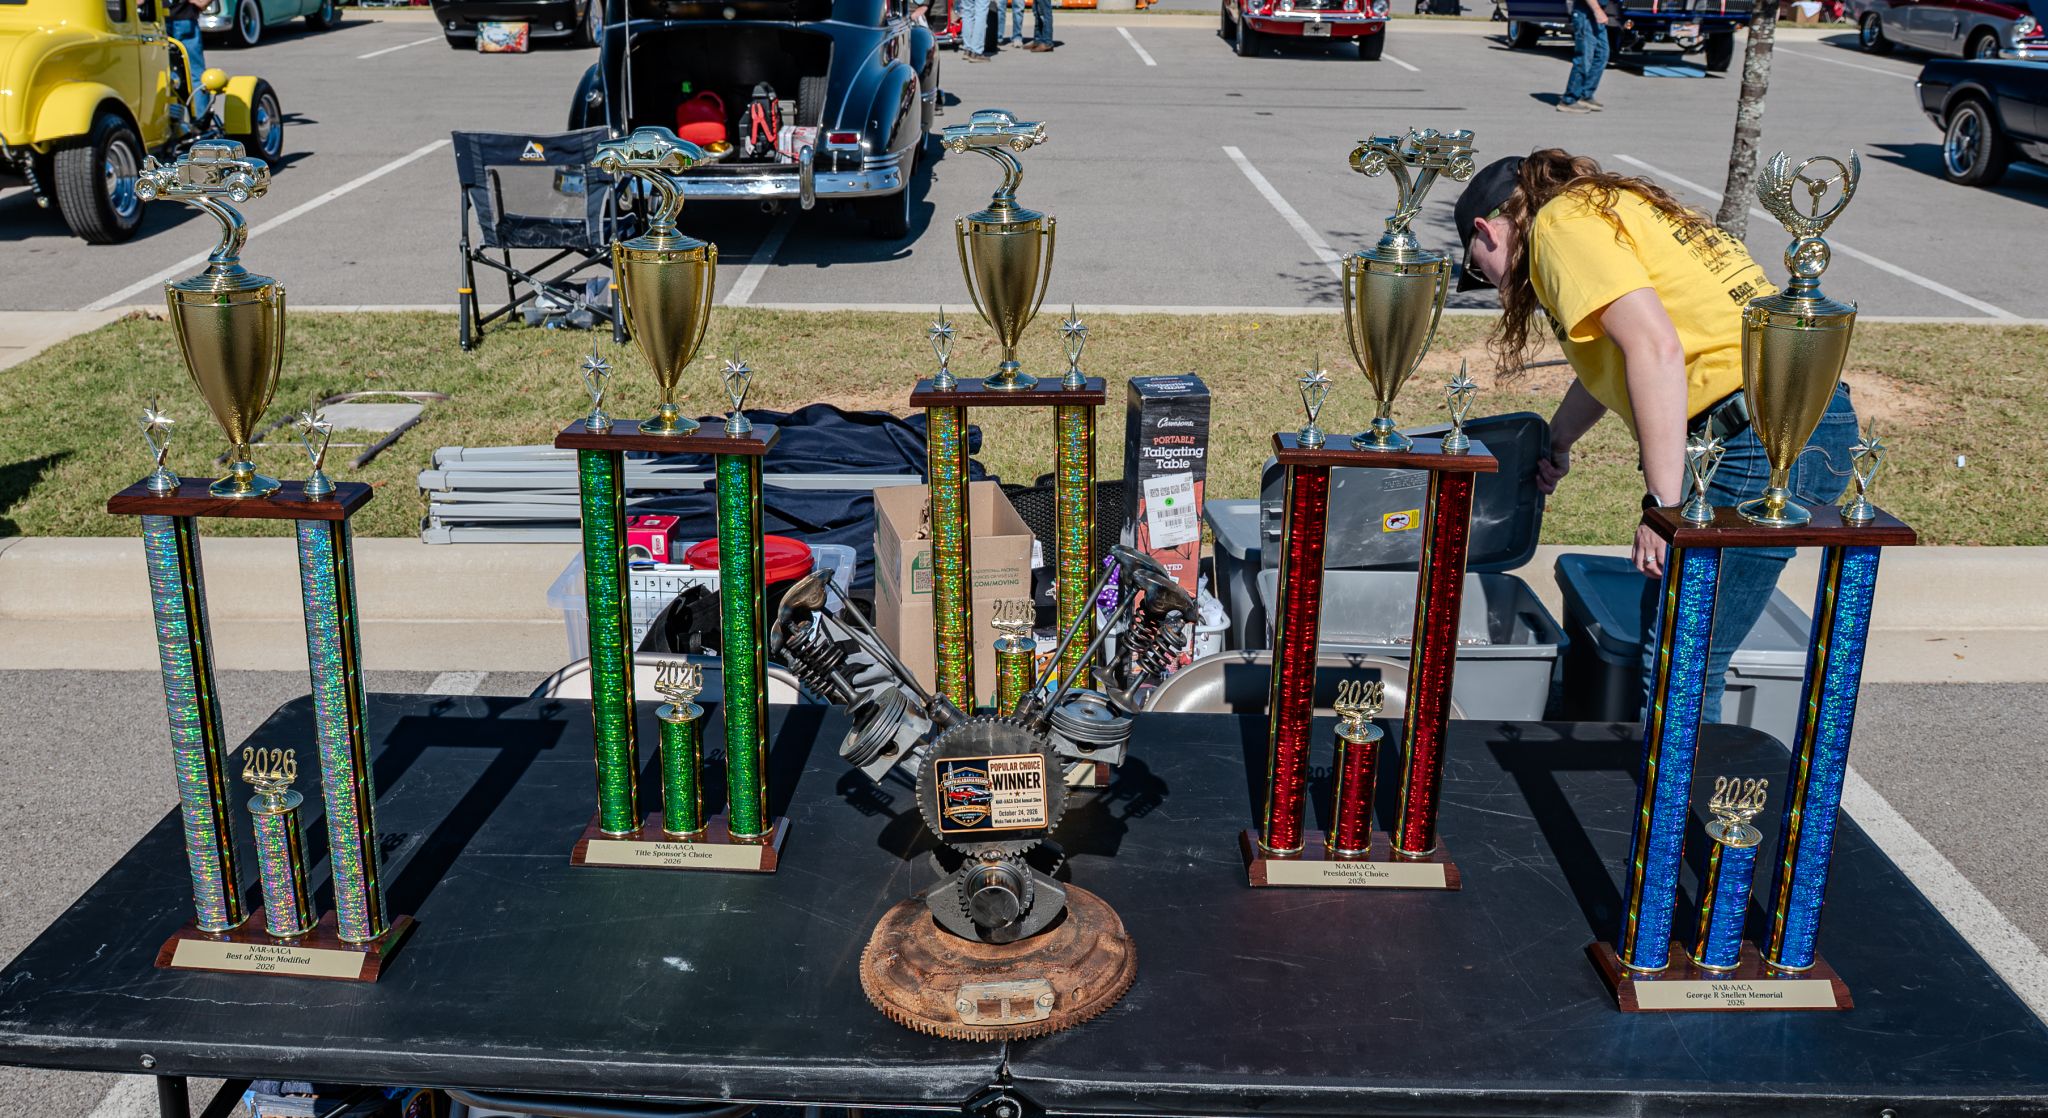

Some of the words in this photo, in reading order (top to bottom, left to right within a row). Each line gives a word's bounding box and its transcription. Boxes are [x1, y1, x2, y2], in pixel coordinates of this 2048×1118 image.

[1153, 436, 1195, 445] PORTABLE
[1143, 447, 1204, 459] Tailgating
[1156, 459, 1190, 469] Table
[991, 598, 1037, 624] 2026
[654, 660, 704, 689] 2026
[1334, 680, 1385, 708] 2026
[242, 746, 298, 778] 2026
[990, 762, 1018, 772] POPULAR
[1019, 761, 1041, 771] CHOICE
[991, 771, 1041, 791] WINNER
[1709, 776, 1768, 808] 2026
[652, 850, 687, 858] Sponsor's
[688, 851, 713, 859] Choice
[248, 945, 292, 955] NAR-AACA
[225, 952, 242, 960] Best
[254, 954, 275, 962] Show
[276, 955, 311, 964] Modified
[255, 962, 275, 970] 2026
[1686, 991, 1712, 1000] George
[1748, 991, 1783, 999] Memorial
